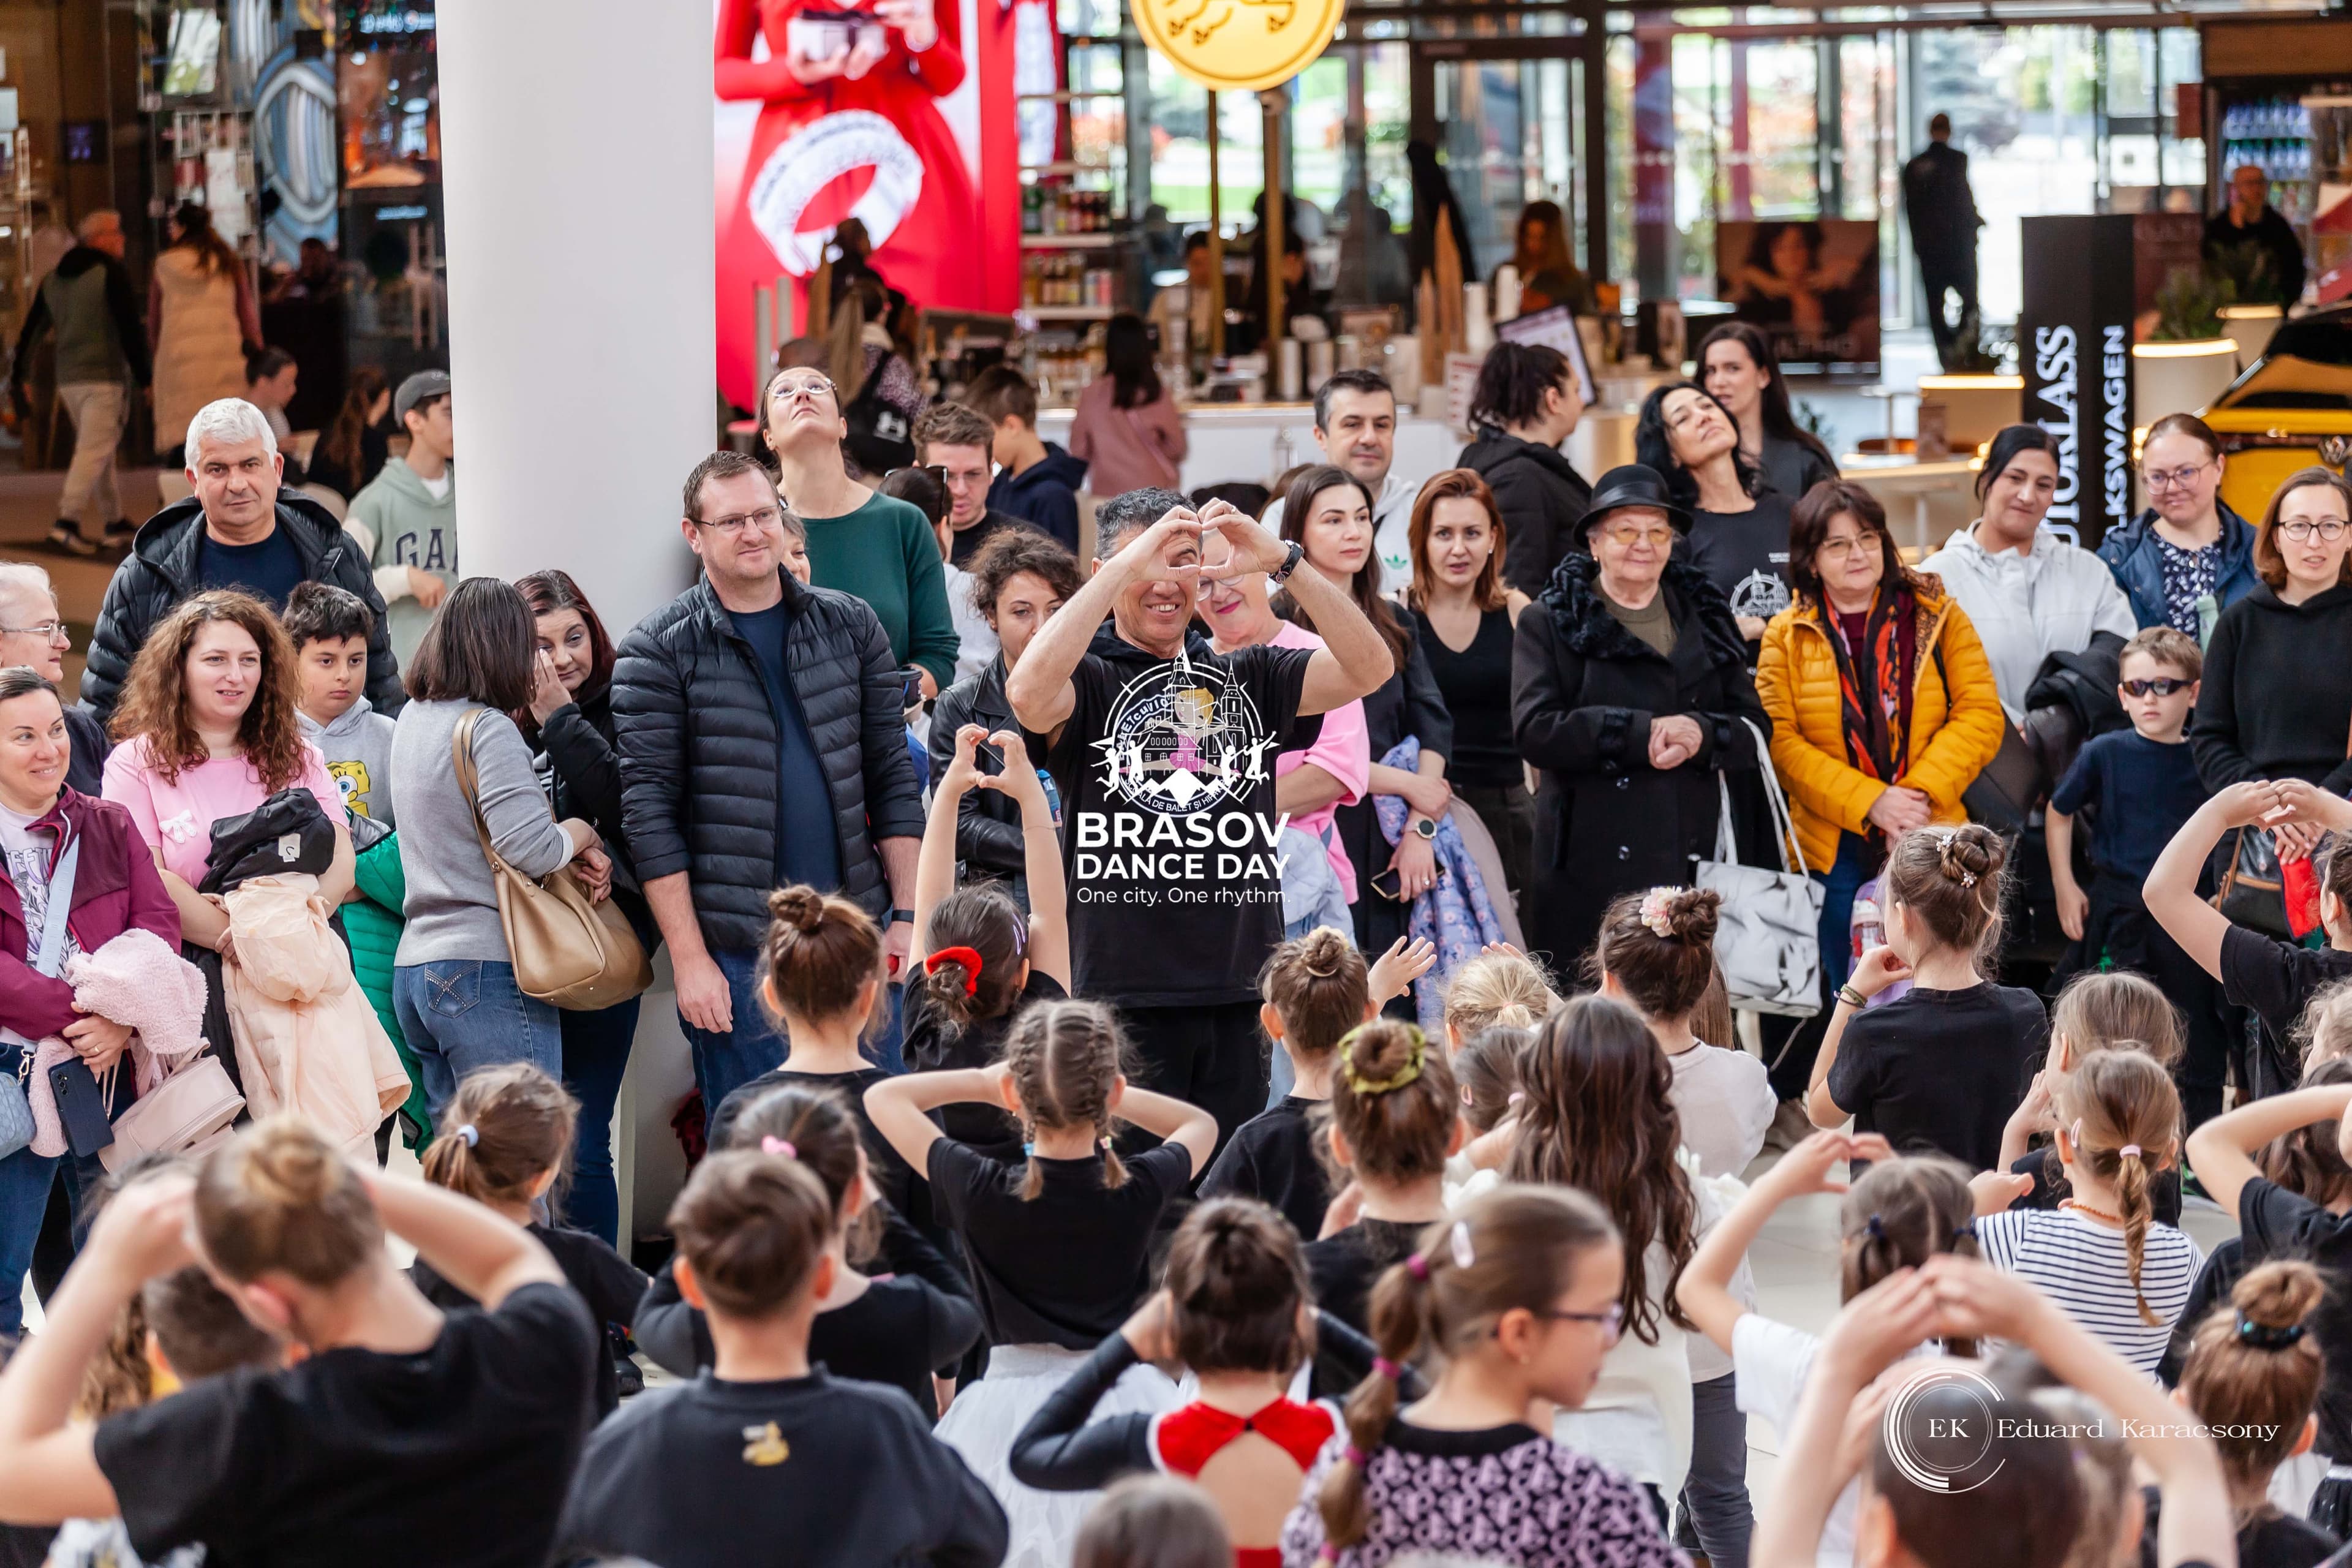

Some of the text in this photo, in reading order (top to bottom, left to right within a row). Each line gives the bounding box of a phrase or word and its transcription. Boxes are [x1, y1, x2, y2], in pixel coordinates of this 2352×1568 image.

[2035, 325, 2080, 547] UTOLASS
[2103, 325, 2128, 535] LKSWAGEN
[396, 527, 459, 573] GA
[1152, 799, 1164, 810] DE
